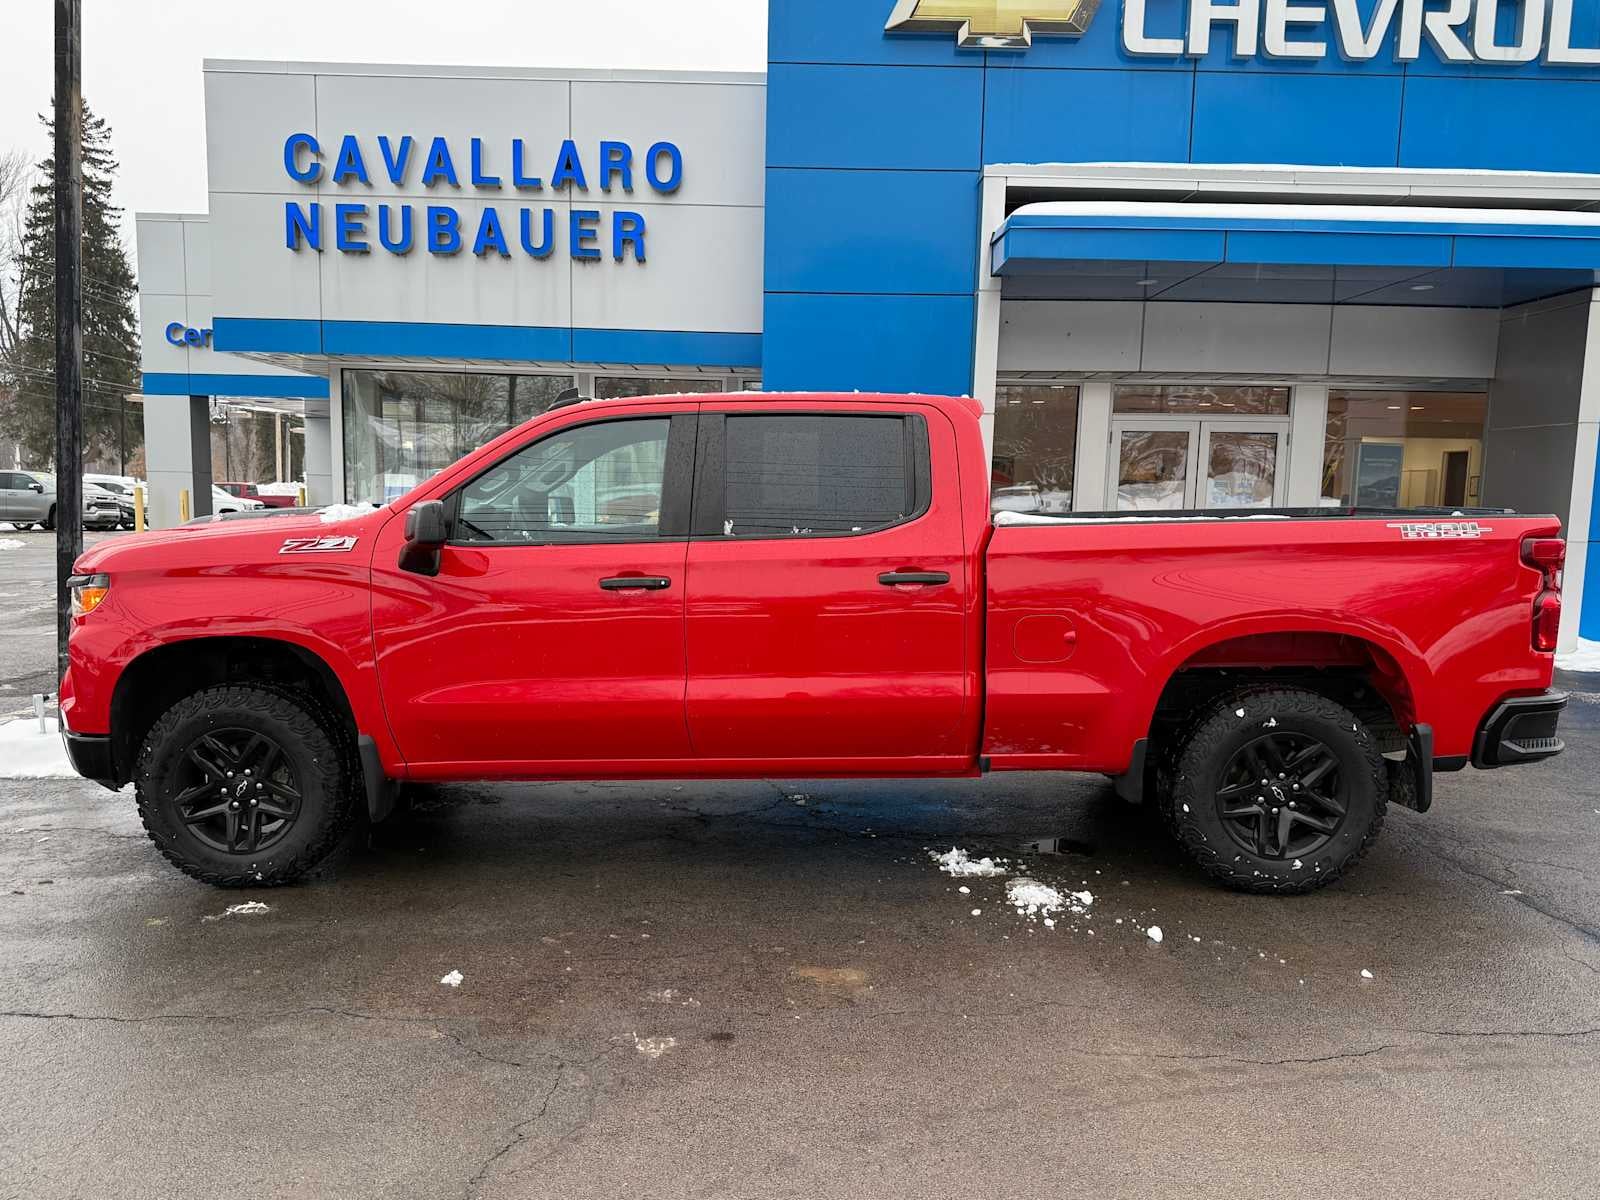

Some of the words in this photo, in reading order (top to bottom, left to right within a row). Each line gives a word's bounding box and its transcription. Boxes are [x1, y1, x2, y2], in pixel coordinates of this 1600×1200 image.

[284, 132, 683, 194] CAVALLARO
[285, 201, 647, 263] NEUBAUER
[165, 321, 213, 347] Cer
[1387, 522, 1492, 532] TRAIL
[1401, 530, 1481, 540] BOSS
[278, 536, 359, 554] Z71
